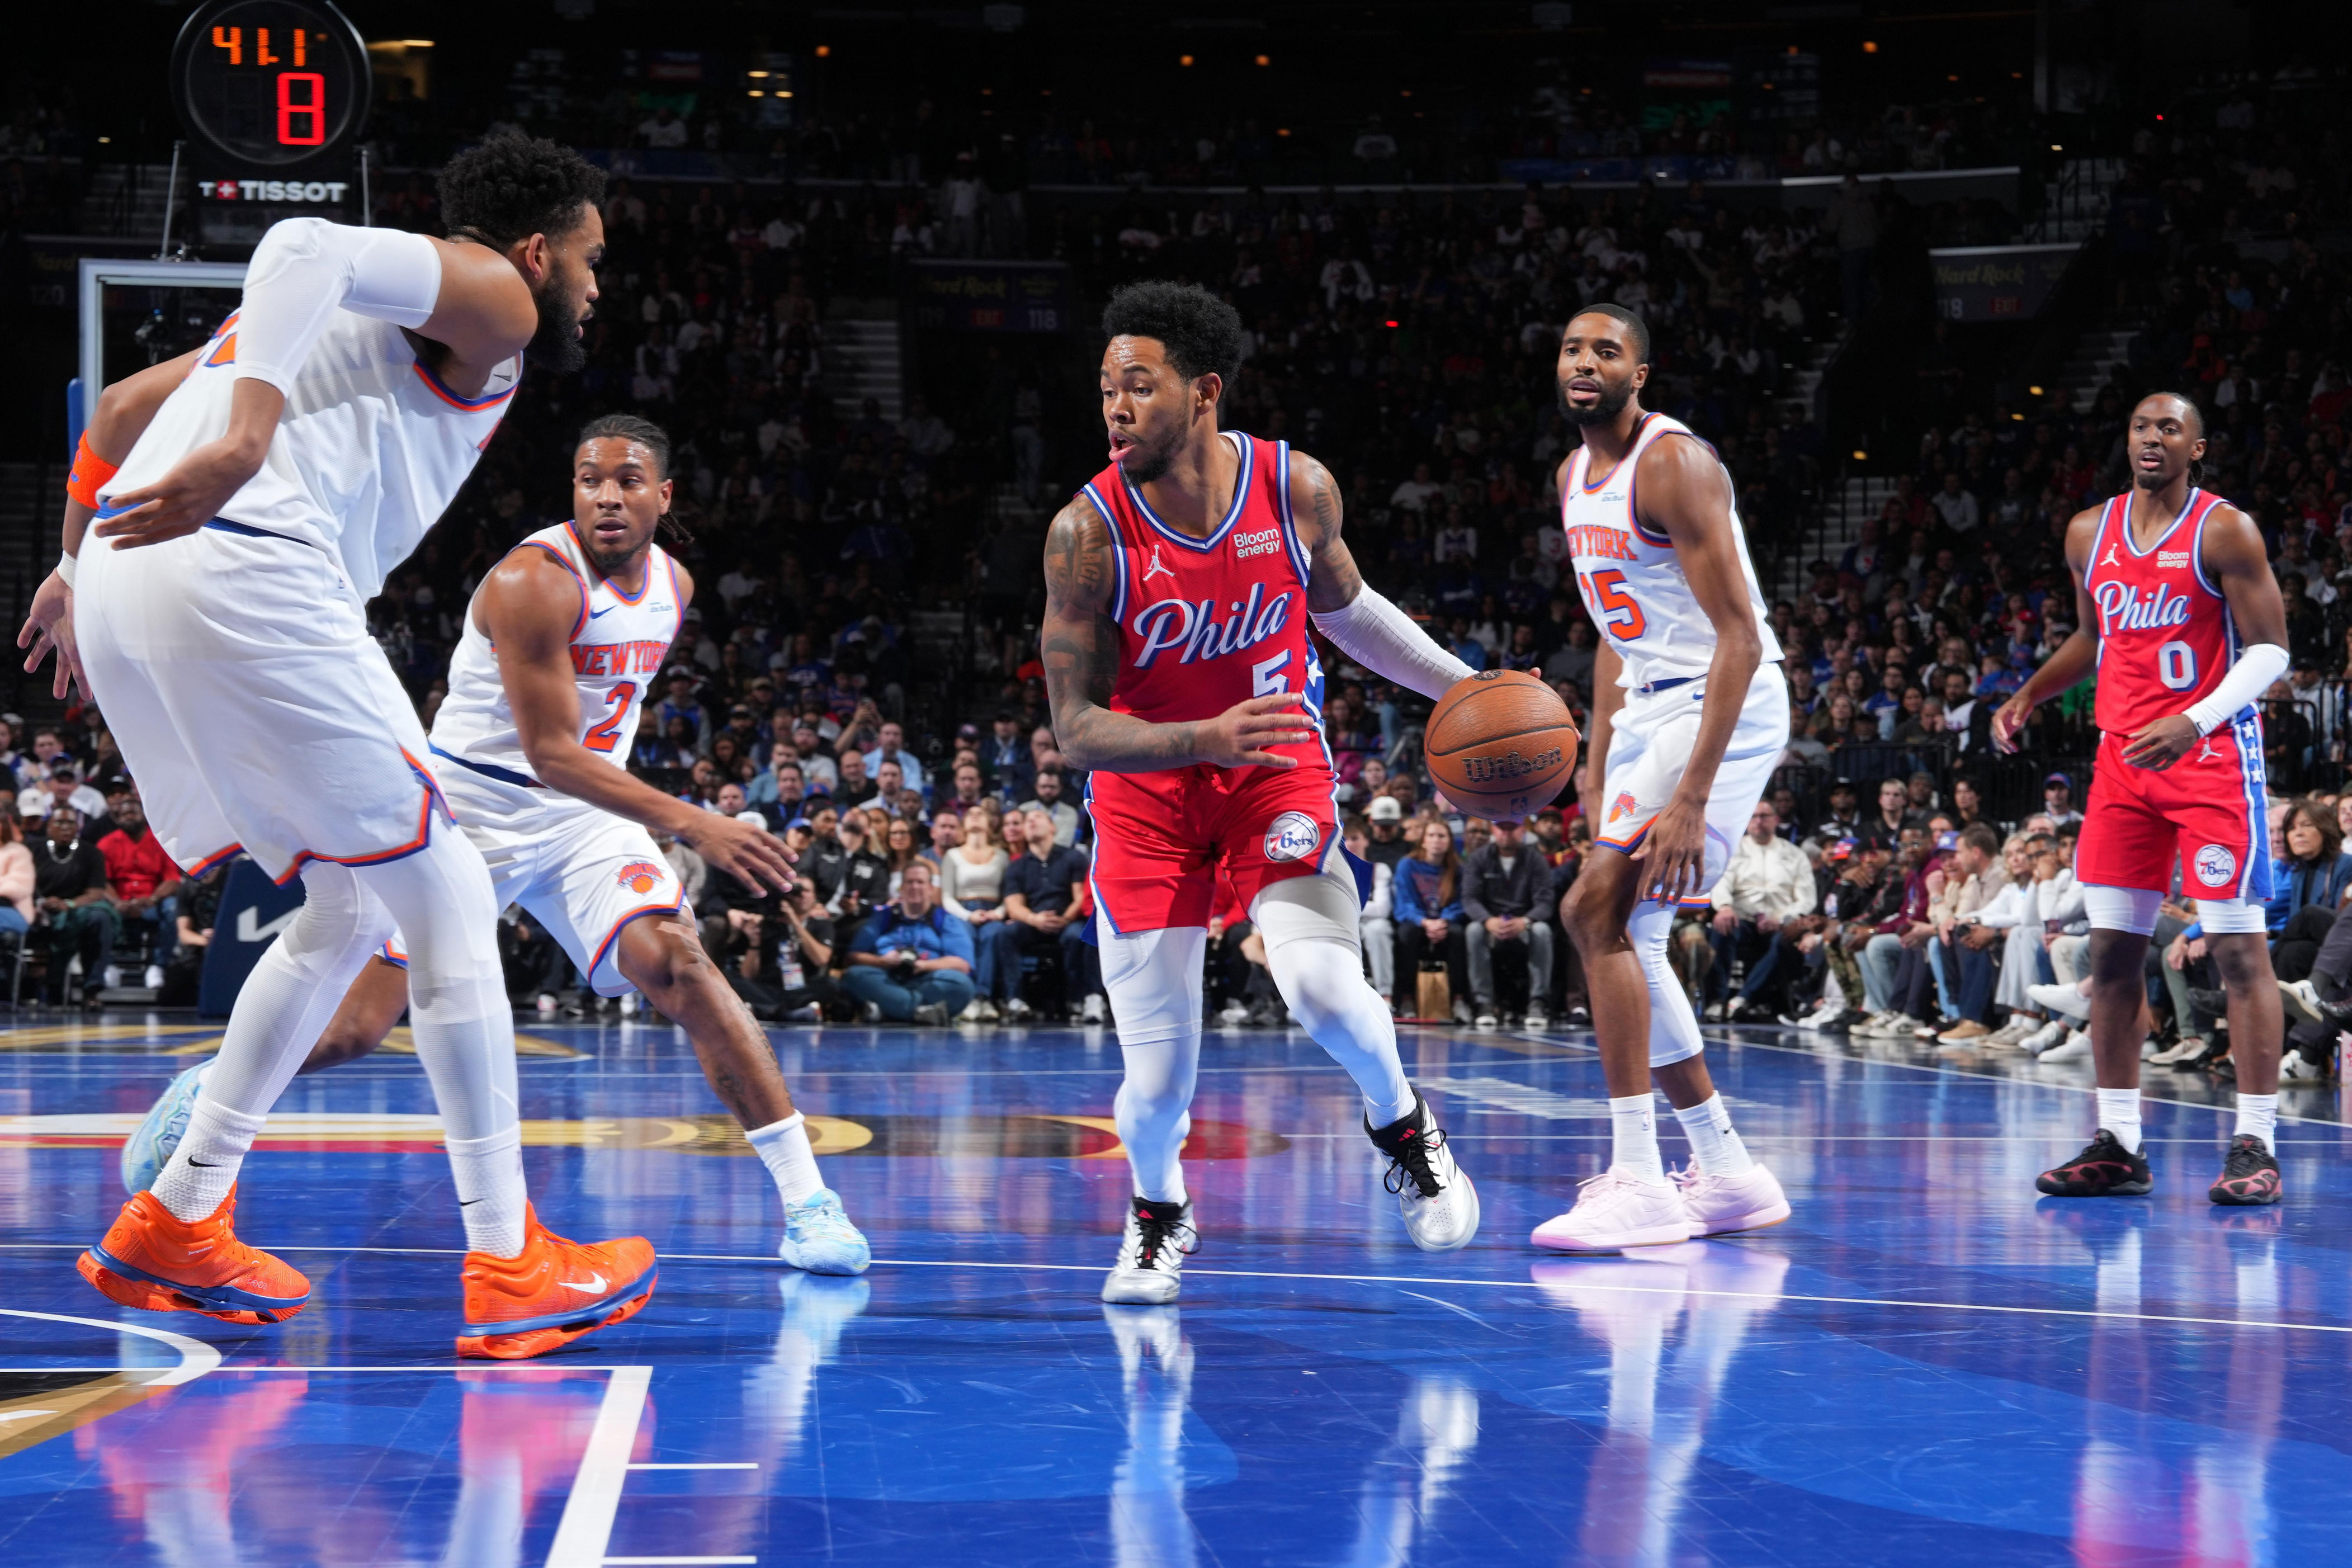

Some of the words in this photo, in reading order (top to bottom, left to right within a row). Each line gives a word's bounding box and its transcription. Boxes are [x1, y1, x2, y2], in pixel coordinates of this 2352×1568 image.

[277, 72, 325, 145] 8
[239, 181, 349, 202] TISSOT
[1233, 528, 1279, 547] Bloom
[1237, 539, 1280, 558] energy
[1584, 525, 1639, 561] YORK
[2156, 560, 2189, 568] energy
[2157, 551, 2189, 561] Bloom
[1133, 583, 1293, 670] Phila
[2094, 582, 2192, 637] Phila
[570, 641, 631, 677] NEW
[1252, 648, 1292, 698] 5
[2158, 640, 2200, 693] 0
[581, 681, 636, 753] 2
[1461, 746, 1563, 782] Wilson
[1269, 831, 1315, 854] 76ers
[187, 1245, 213, 1257] Jacqueline
